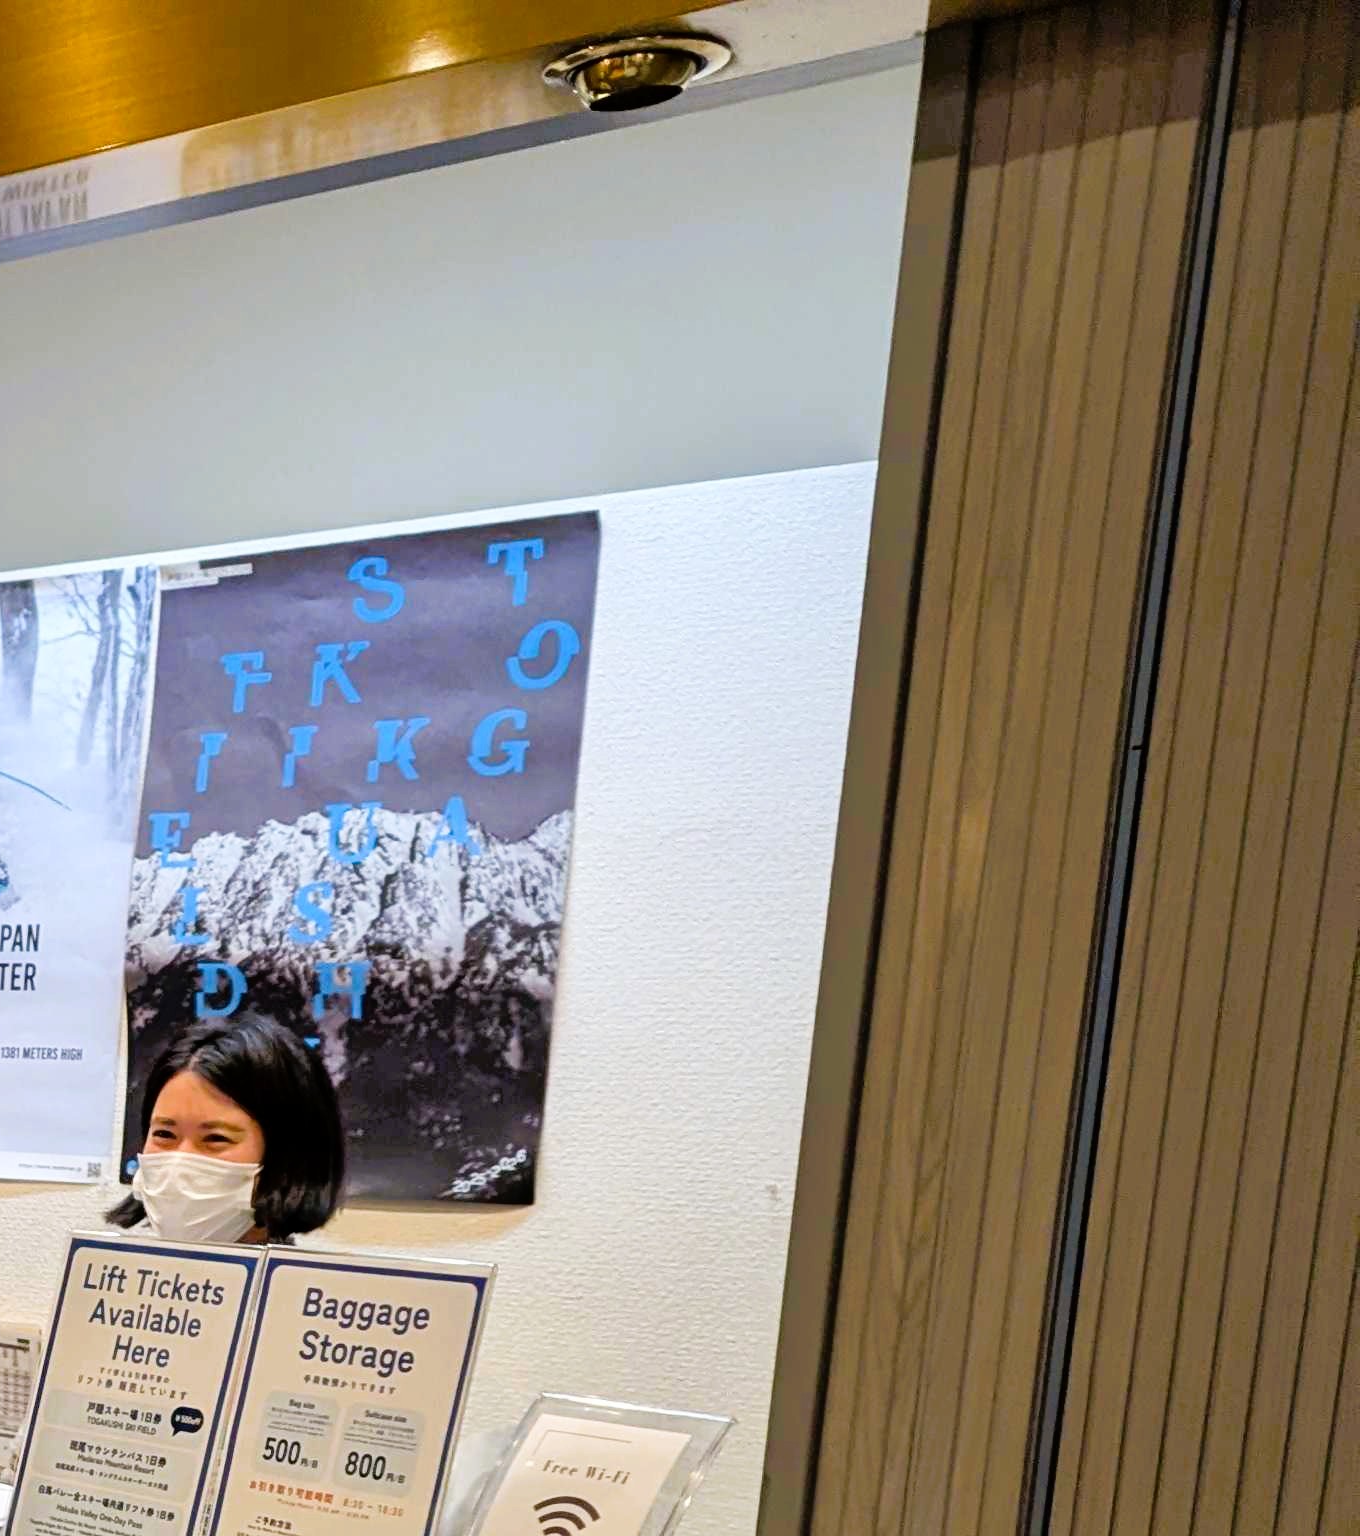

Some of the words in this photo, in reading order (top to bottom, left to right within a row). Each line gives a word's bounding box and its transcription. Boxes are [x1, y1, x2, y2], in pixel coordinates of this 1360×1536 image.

[0, 1046, 20, 1059] 1381
[22, 1047, 58, 1060] METERS
[60, 1048, 83, 1061] HIGH
[83, 1263, 128, 1294] Lift
[137, 1268, 225, 1306] Tickets
[88, 1298, 202, 1338] Available
[302, 1286, 430, 1336] Baggage
[111, 1334, 170, 1368] Here
[298, 1329, 415, 1378] Storage
[134, 1424, 157, 1436] FIELD
[542, 1459, 578, 1477] Free
[585, 1466, 631, 1485] Wi-Fi
